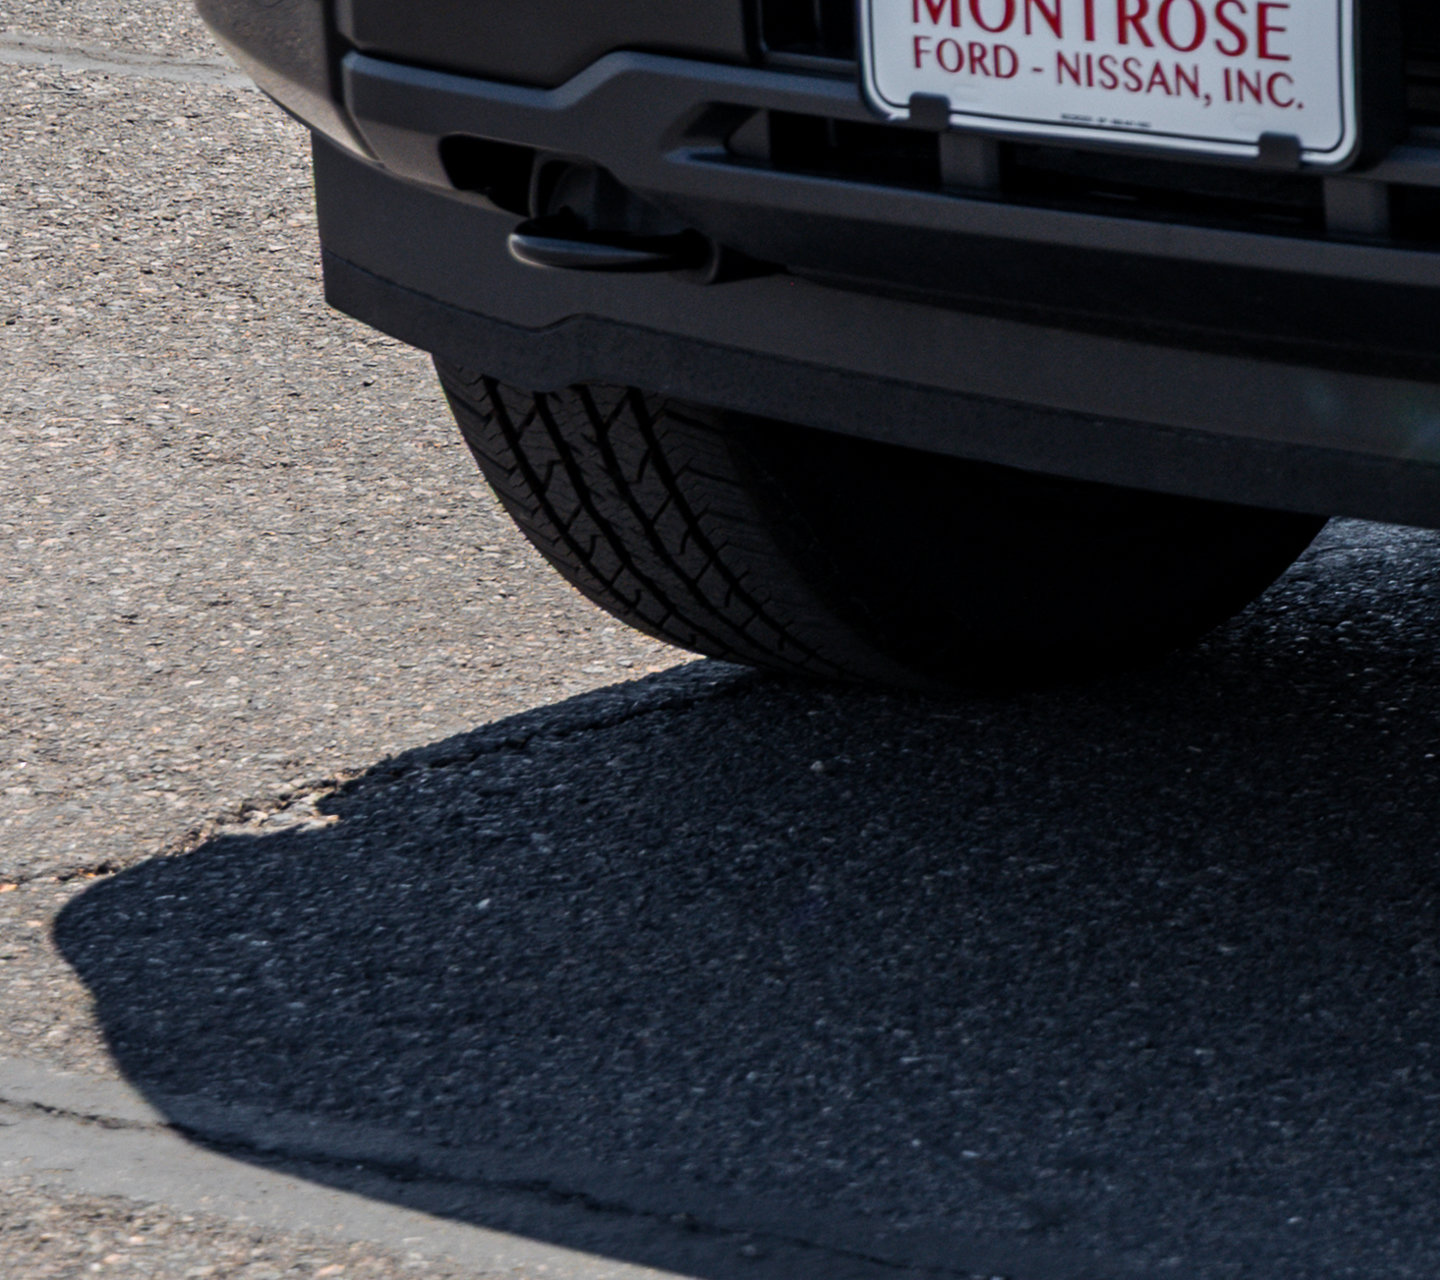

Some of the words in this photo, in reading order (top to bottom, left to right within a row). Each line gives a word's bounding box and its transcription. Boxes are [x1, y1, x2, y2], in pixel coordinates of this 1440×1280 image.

[913, 35, 1020, 80] FORD
[1055, 50, 1213, 107] NISSAN,
[1224, 66, 1305, 110] INC.
